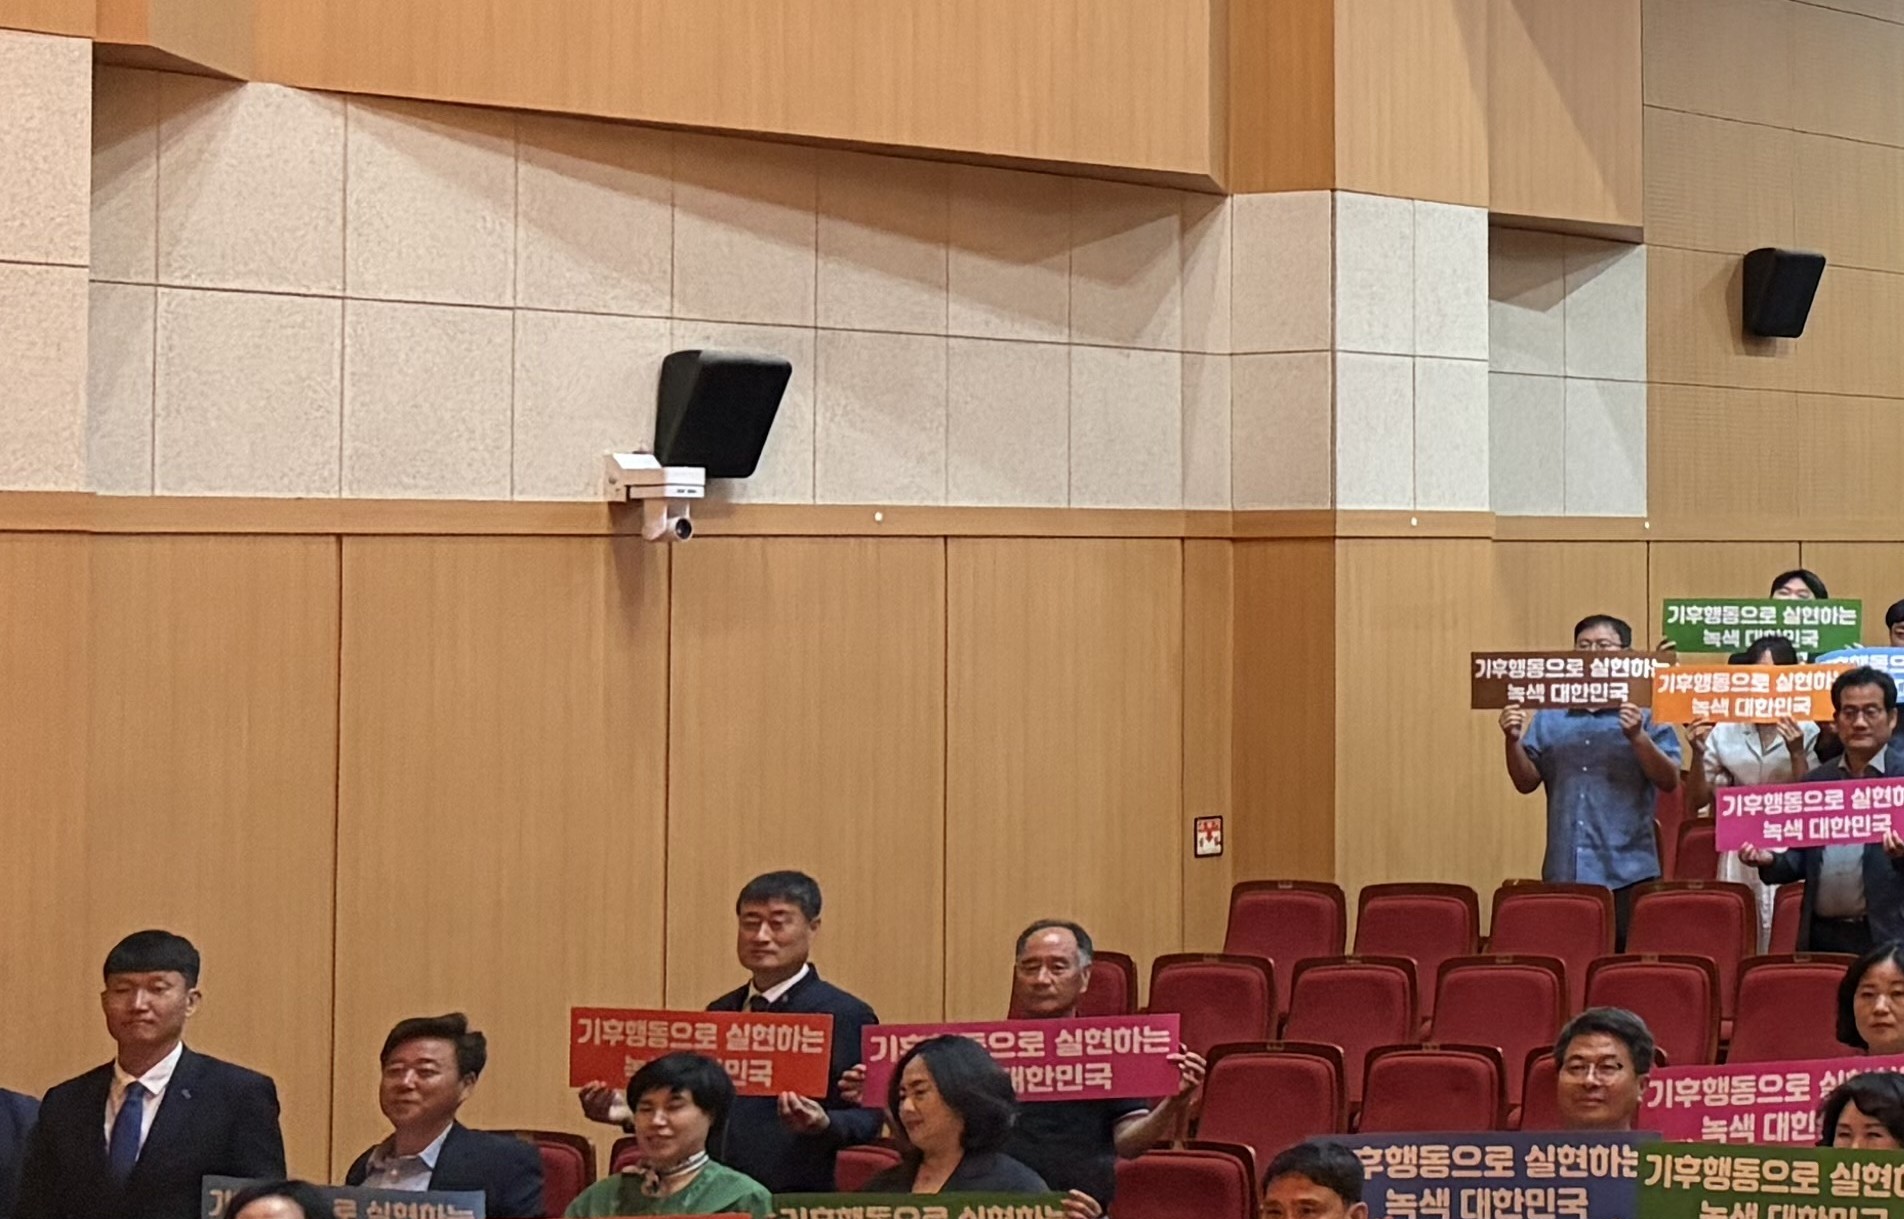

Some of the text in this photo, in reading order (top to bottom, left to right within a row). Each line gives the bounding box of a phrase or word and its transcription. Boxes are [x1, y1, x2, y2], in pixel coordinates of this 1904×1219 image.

[1476, 659, 1584, 678] 기후행동으로
[1508, 683, 1628, 703] 녹색 대한민국
[1723, 789, 1844, 816] 기후행동으로
[1763, 814, 1893, 841] 녹색 대한민국
[1645, 1155, 1819, 1194] 기후행동으로
